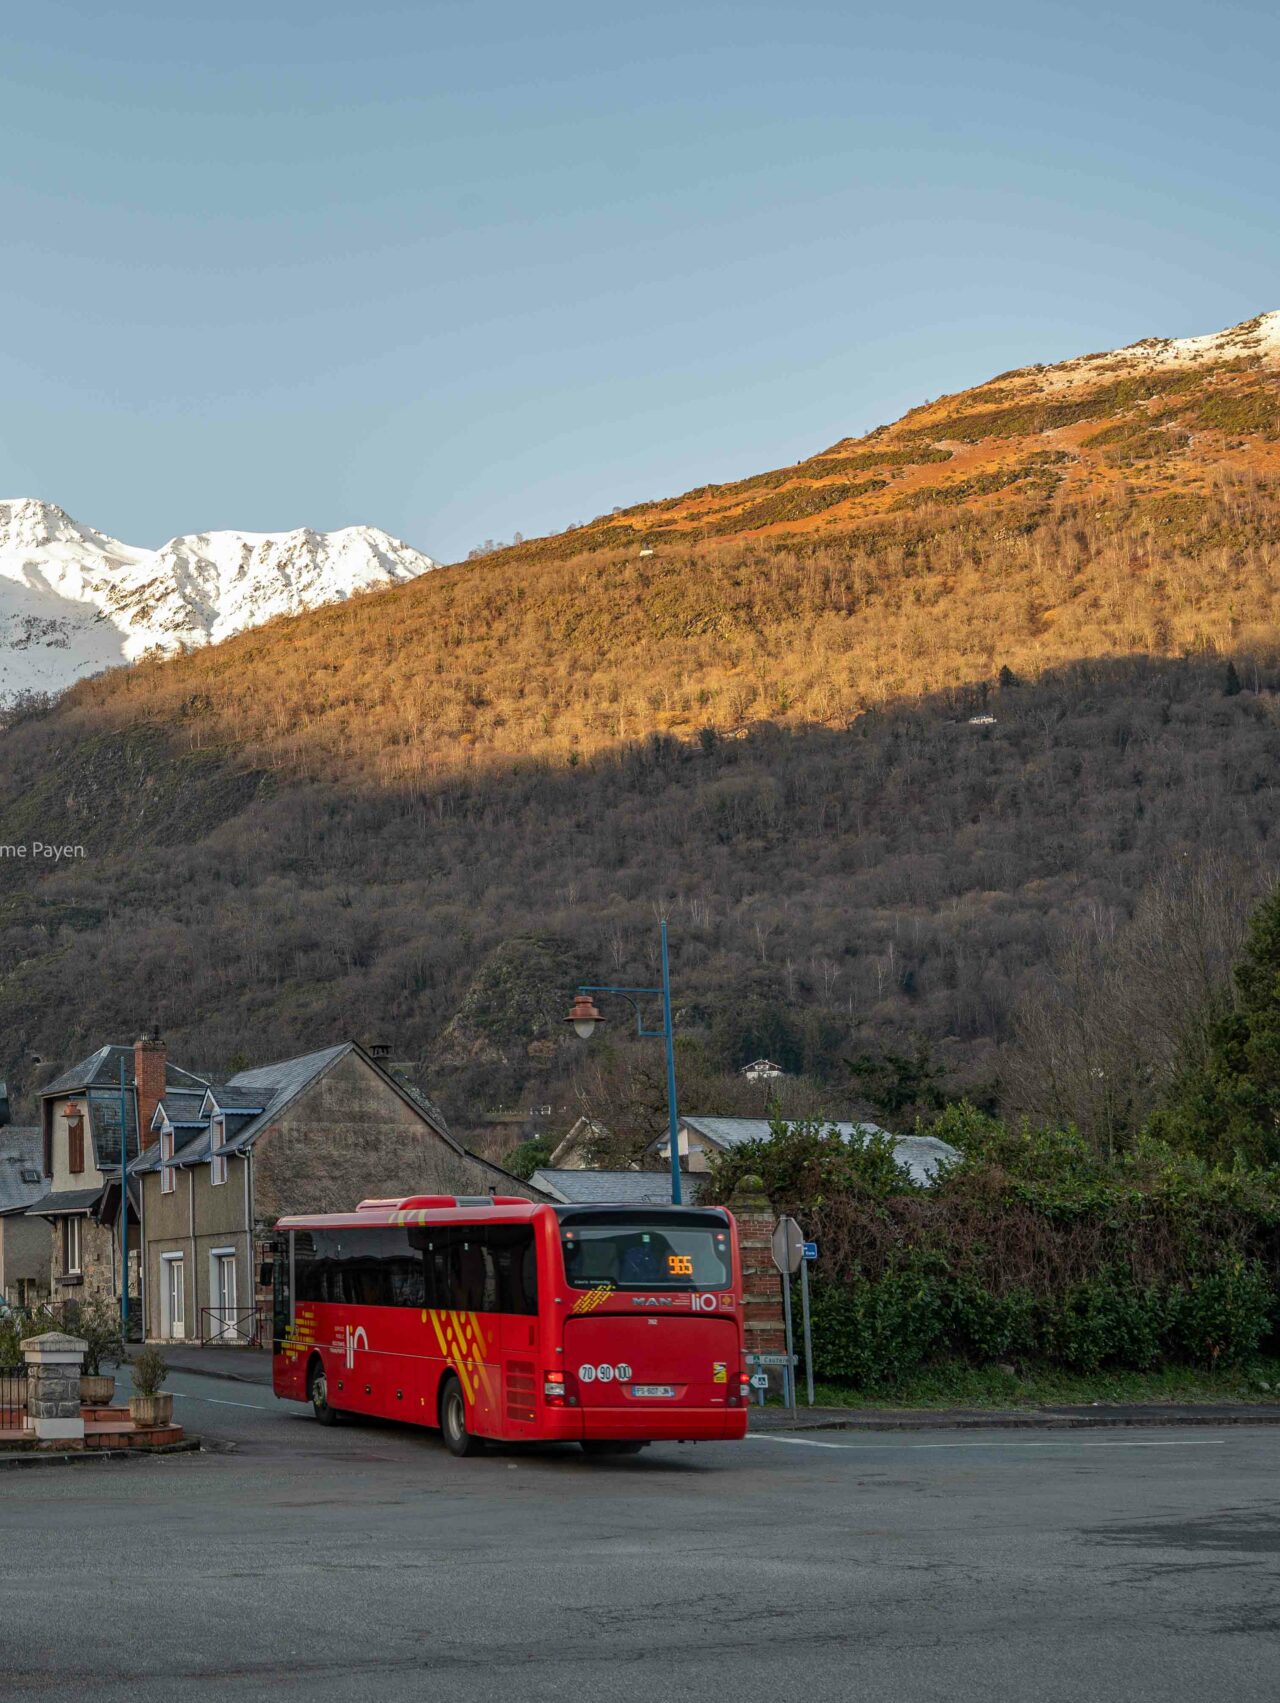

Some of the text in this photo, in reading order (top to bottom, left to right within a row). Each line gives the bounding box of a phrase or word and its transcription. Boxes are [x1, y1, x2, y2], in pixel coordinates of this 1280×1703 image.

[668, 1255, 693, 1274] 965
[632, 1297, 673, 1306] MAN
[582, 1366, 593, 1380] 70
[600, 1366, 610, 1380] 90
[617, 1365, 631, 1379] 100
